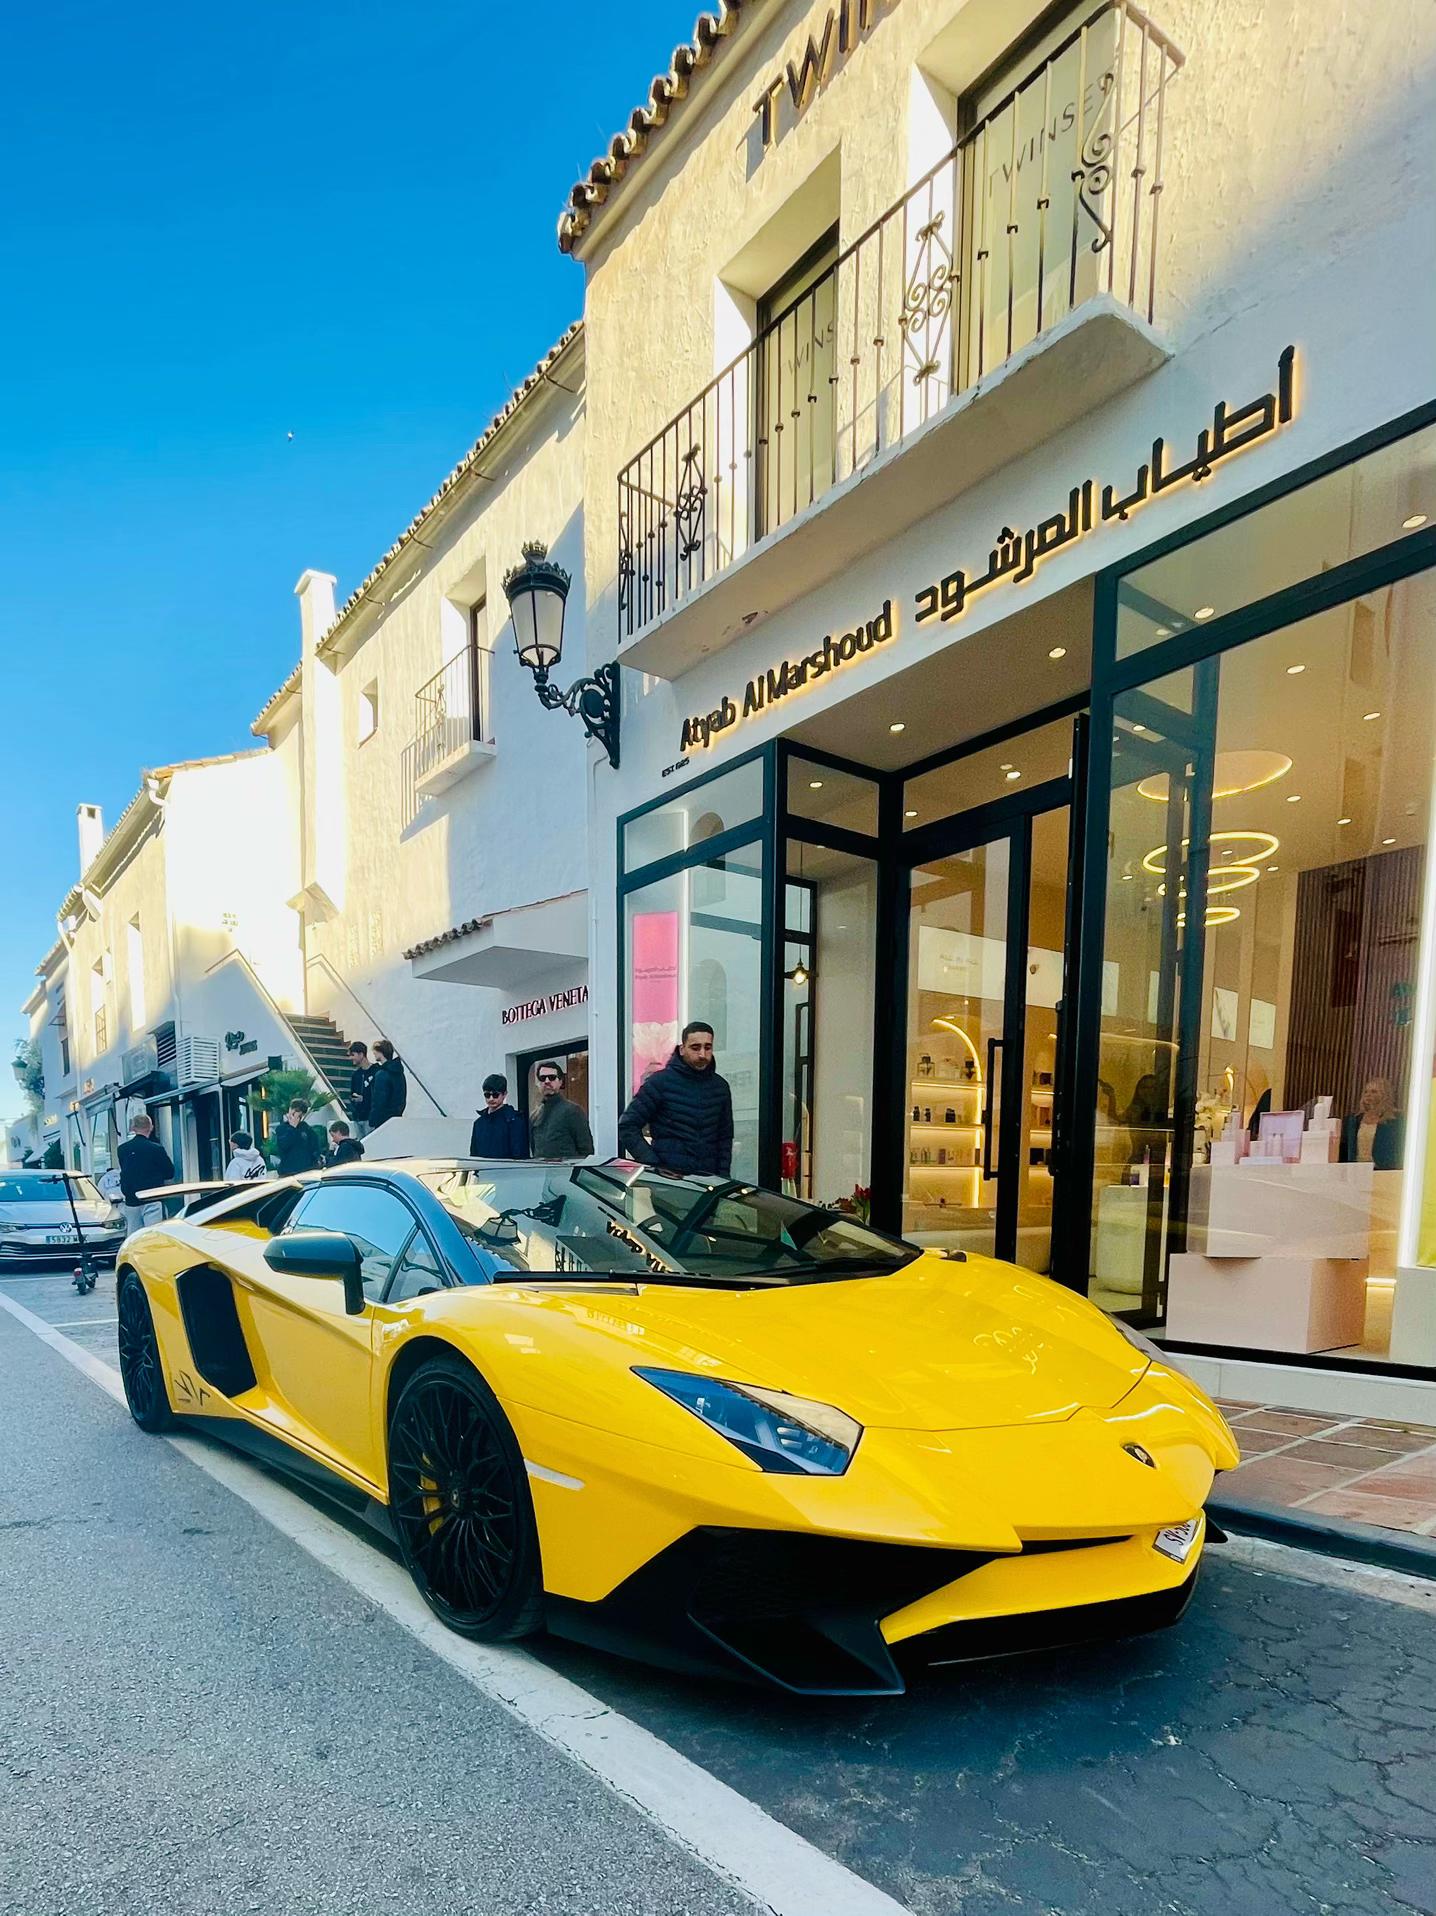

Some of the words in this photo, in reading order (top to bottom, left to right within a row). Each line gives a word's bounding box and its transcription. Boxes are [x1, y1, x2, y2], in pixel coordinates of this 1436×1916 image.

[680, 696, 736, 751] Atyab
[502, 998, 546, 1025] BOTTEGA
[548, 985, 589, 1012] VENETA
